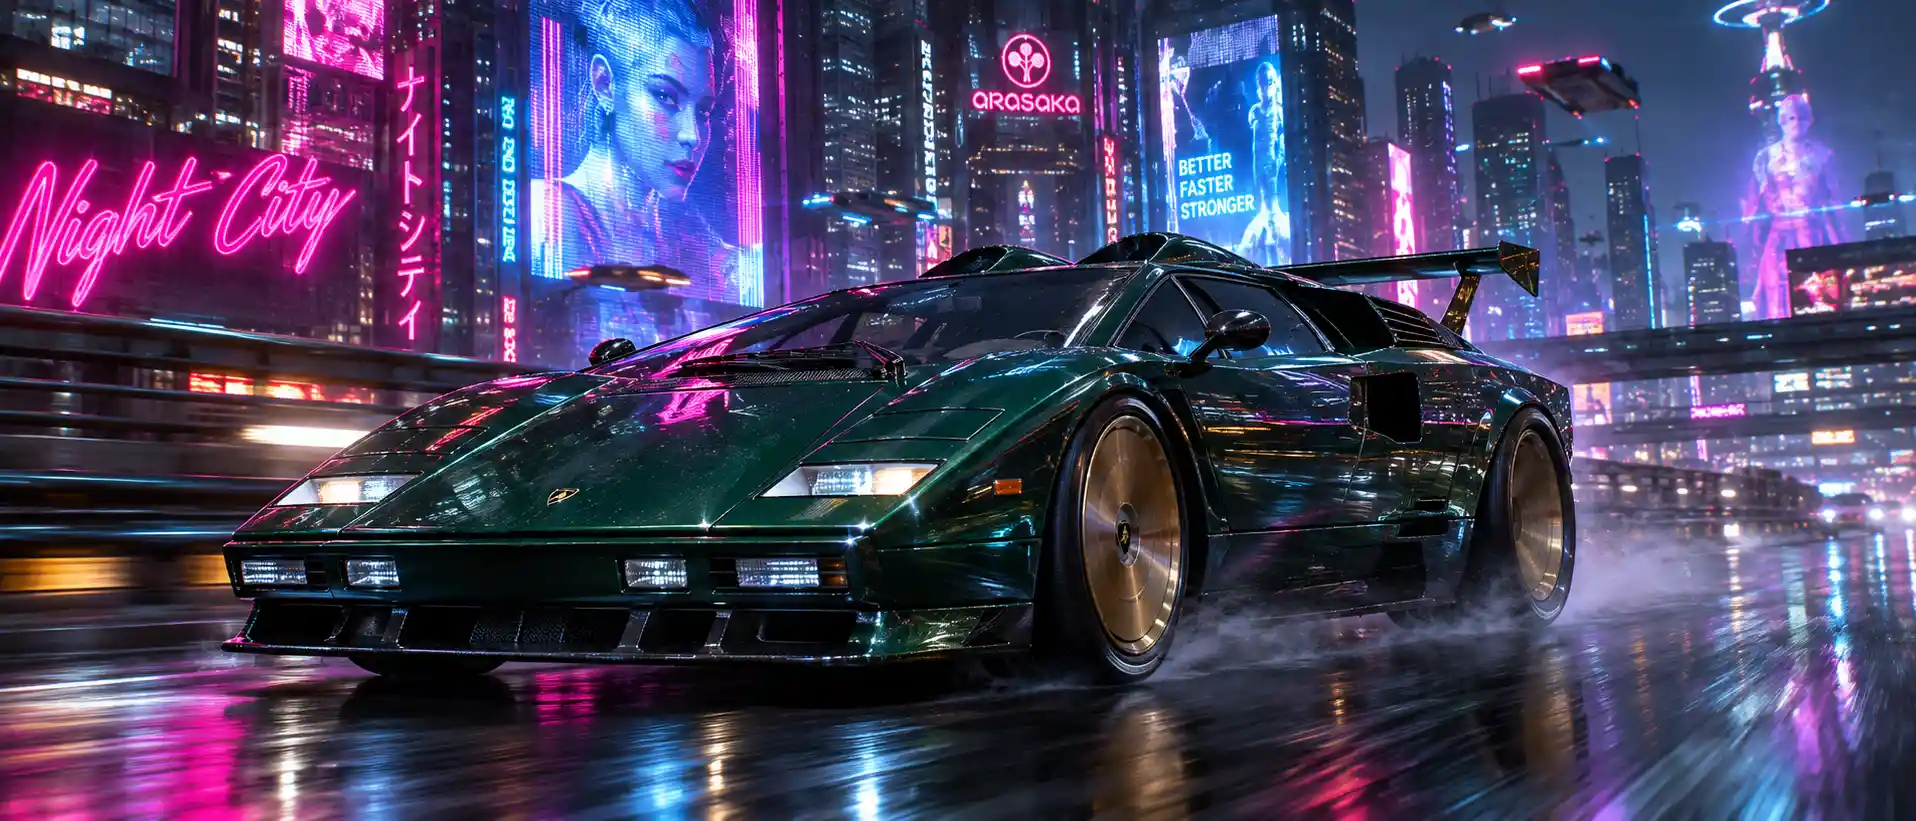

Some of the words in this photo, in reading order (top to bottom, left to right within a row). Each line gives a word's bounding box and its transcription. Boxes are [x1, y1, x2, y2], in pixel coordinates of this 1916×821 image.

[1178, 152, 1233, 177] BETTER
[1180, 174, 1234, 198] FASTER
[1181, 194, 1256, 220] STRONGER
[0, 156, 212, 309] Night
[214, 153, 357, 275] City
